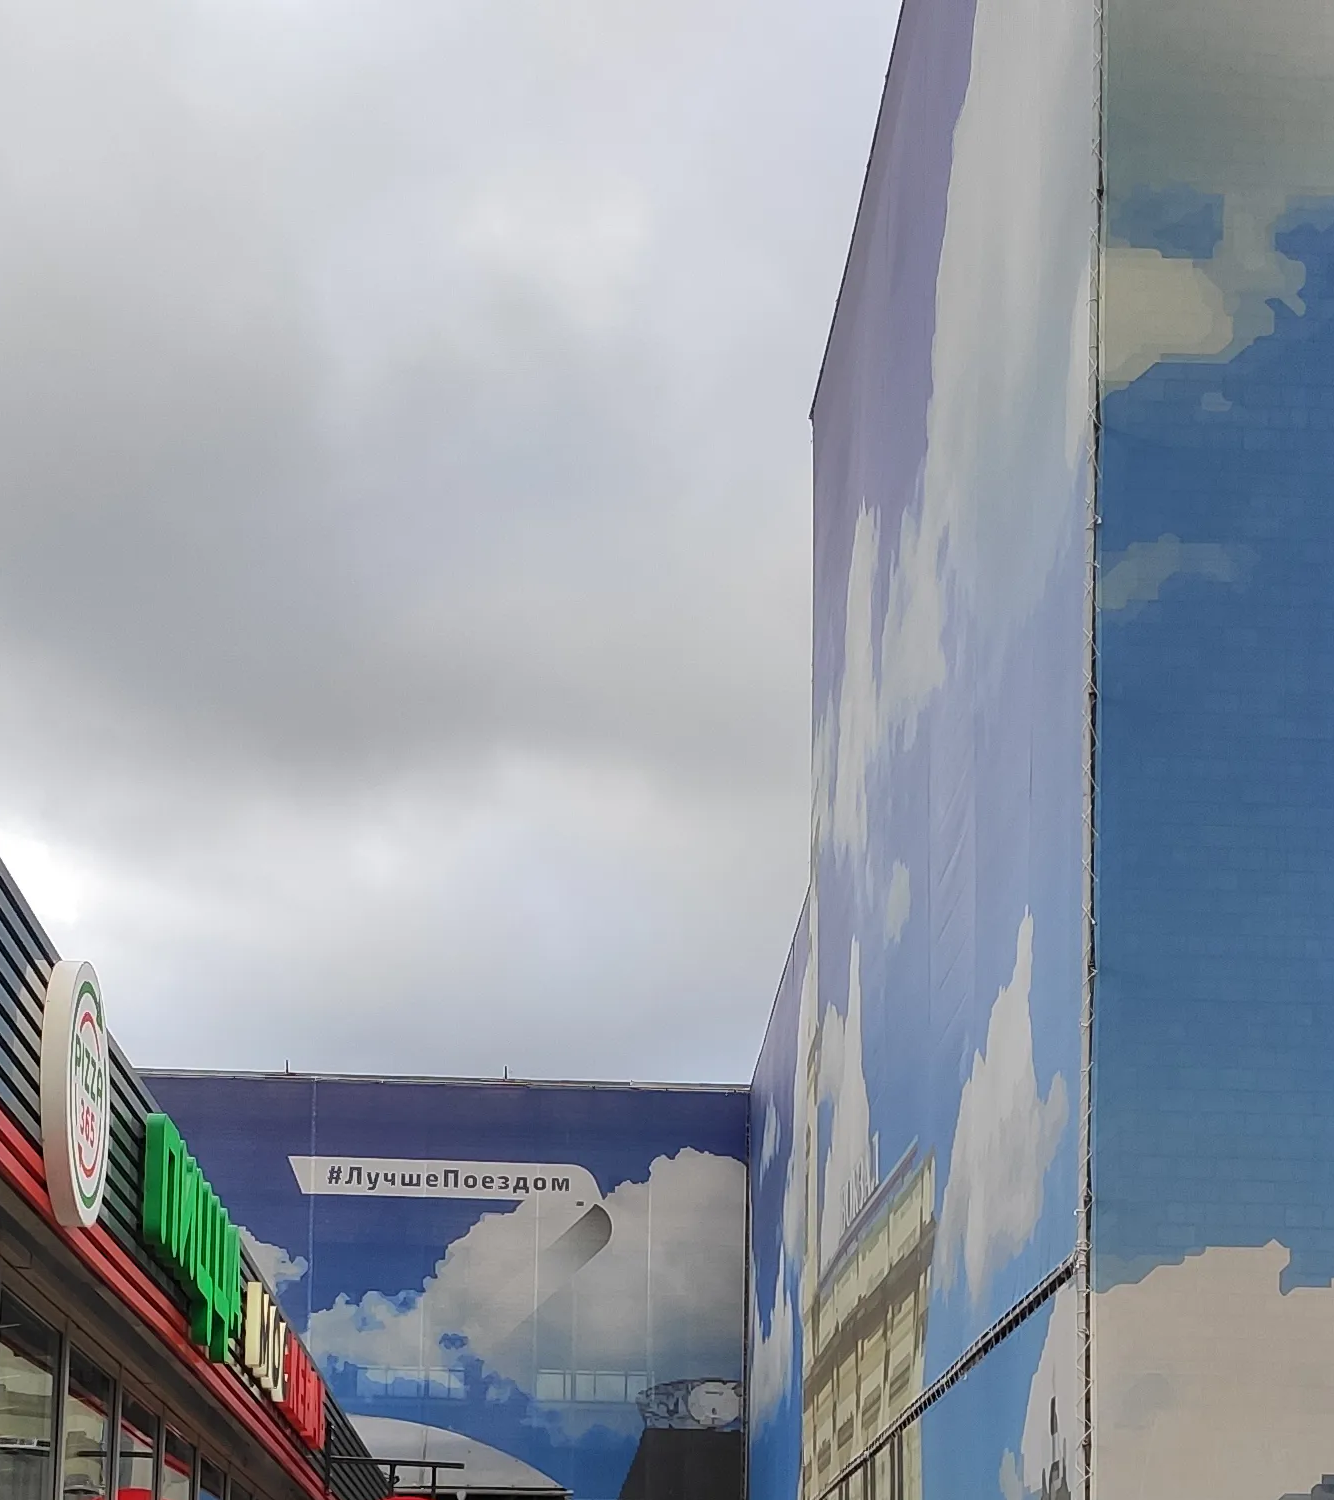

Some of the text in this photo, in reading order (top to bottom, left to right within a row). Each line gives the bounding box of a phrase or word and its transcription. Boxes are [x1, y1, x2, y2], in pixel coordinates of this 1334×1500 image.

[74, 1033, 103, 1113] PIZZA
[80, 1098, 95, 1149] 365
[327, 1164, 571, 1195] #ЛучшеПоездом
[144, 1113, 241, 1364] ПИЦЦА
